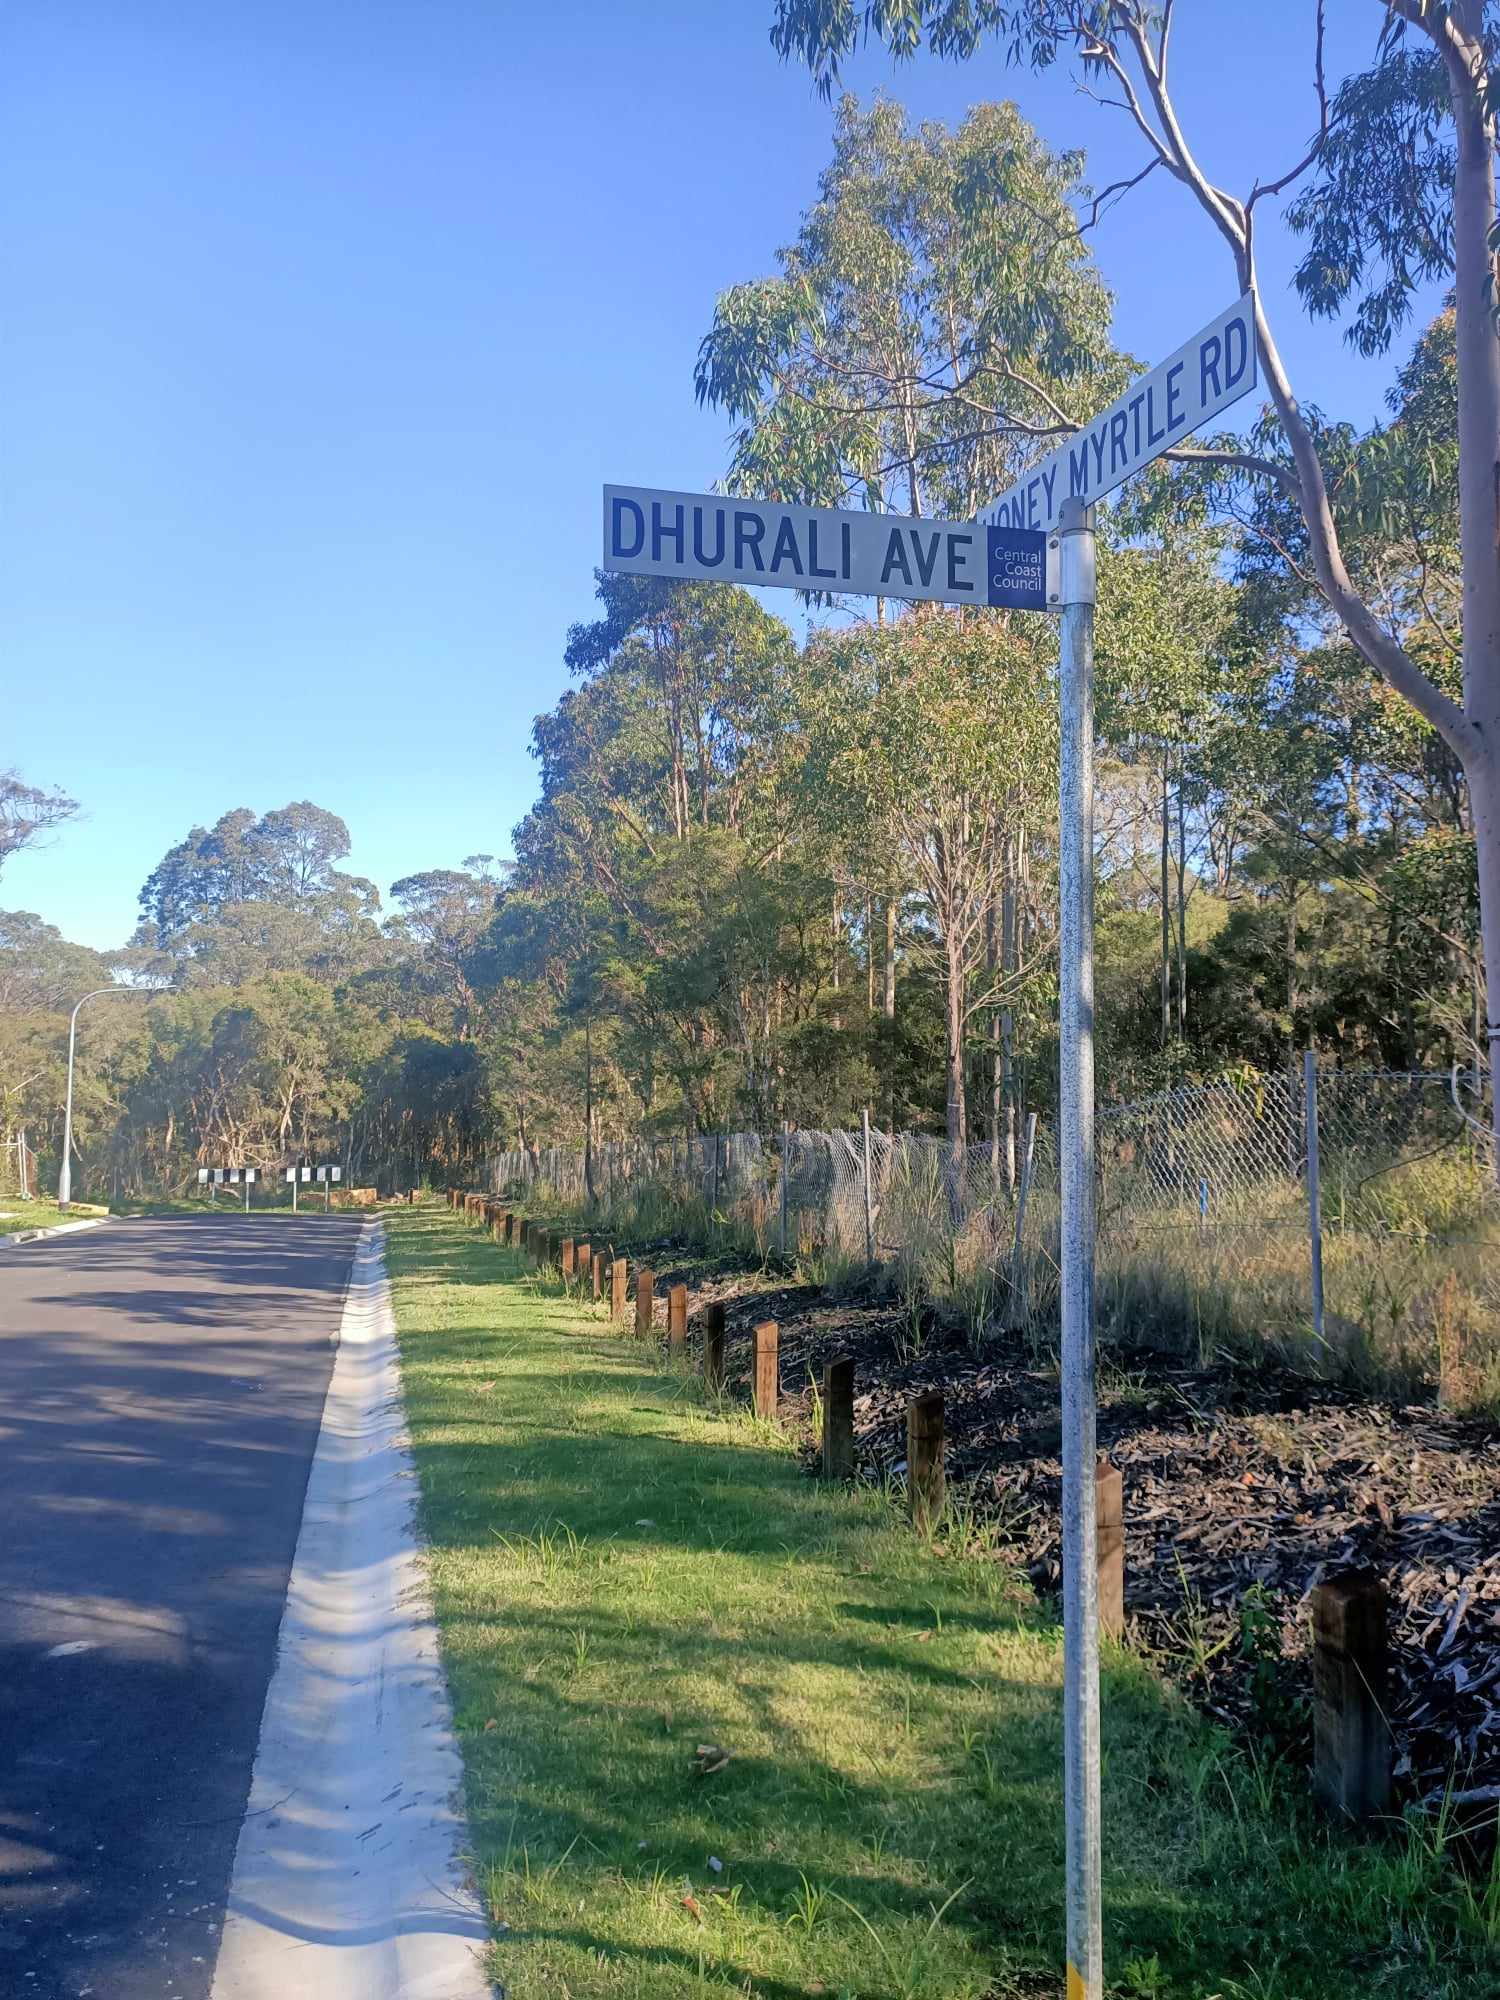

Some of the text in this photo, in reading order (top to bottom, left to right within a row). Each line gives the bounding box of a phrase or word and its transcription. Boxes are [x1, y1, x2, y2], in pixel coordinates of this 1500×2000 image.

[983, 316, 1248, 530] ONEY MYRTLE RD
[611, 497, 975, 591] DHURALI AVE
[994, 546, 1041, 564] Central
[1004, 561, 1042, 578] Coast
[992, 574, 1041, 591] Council
